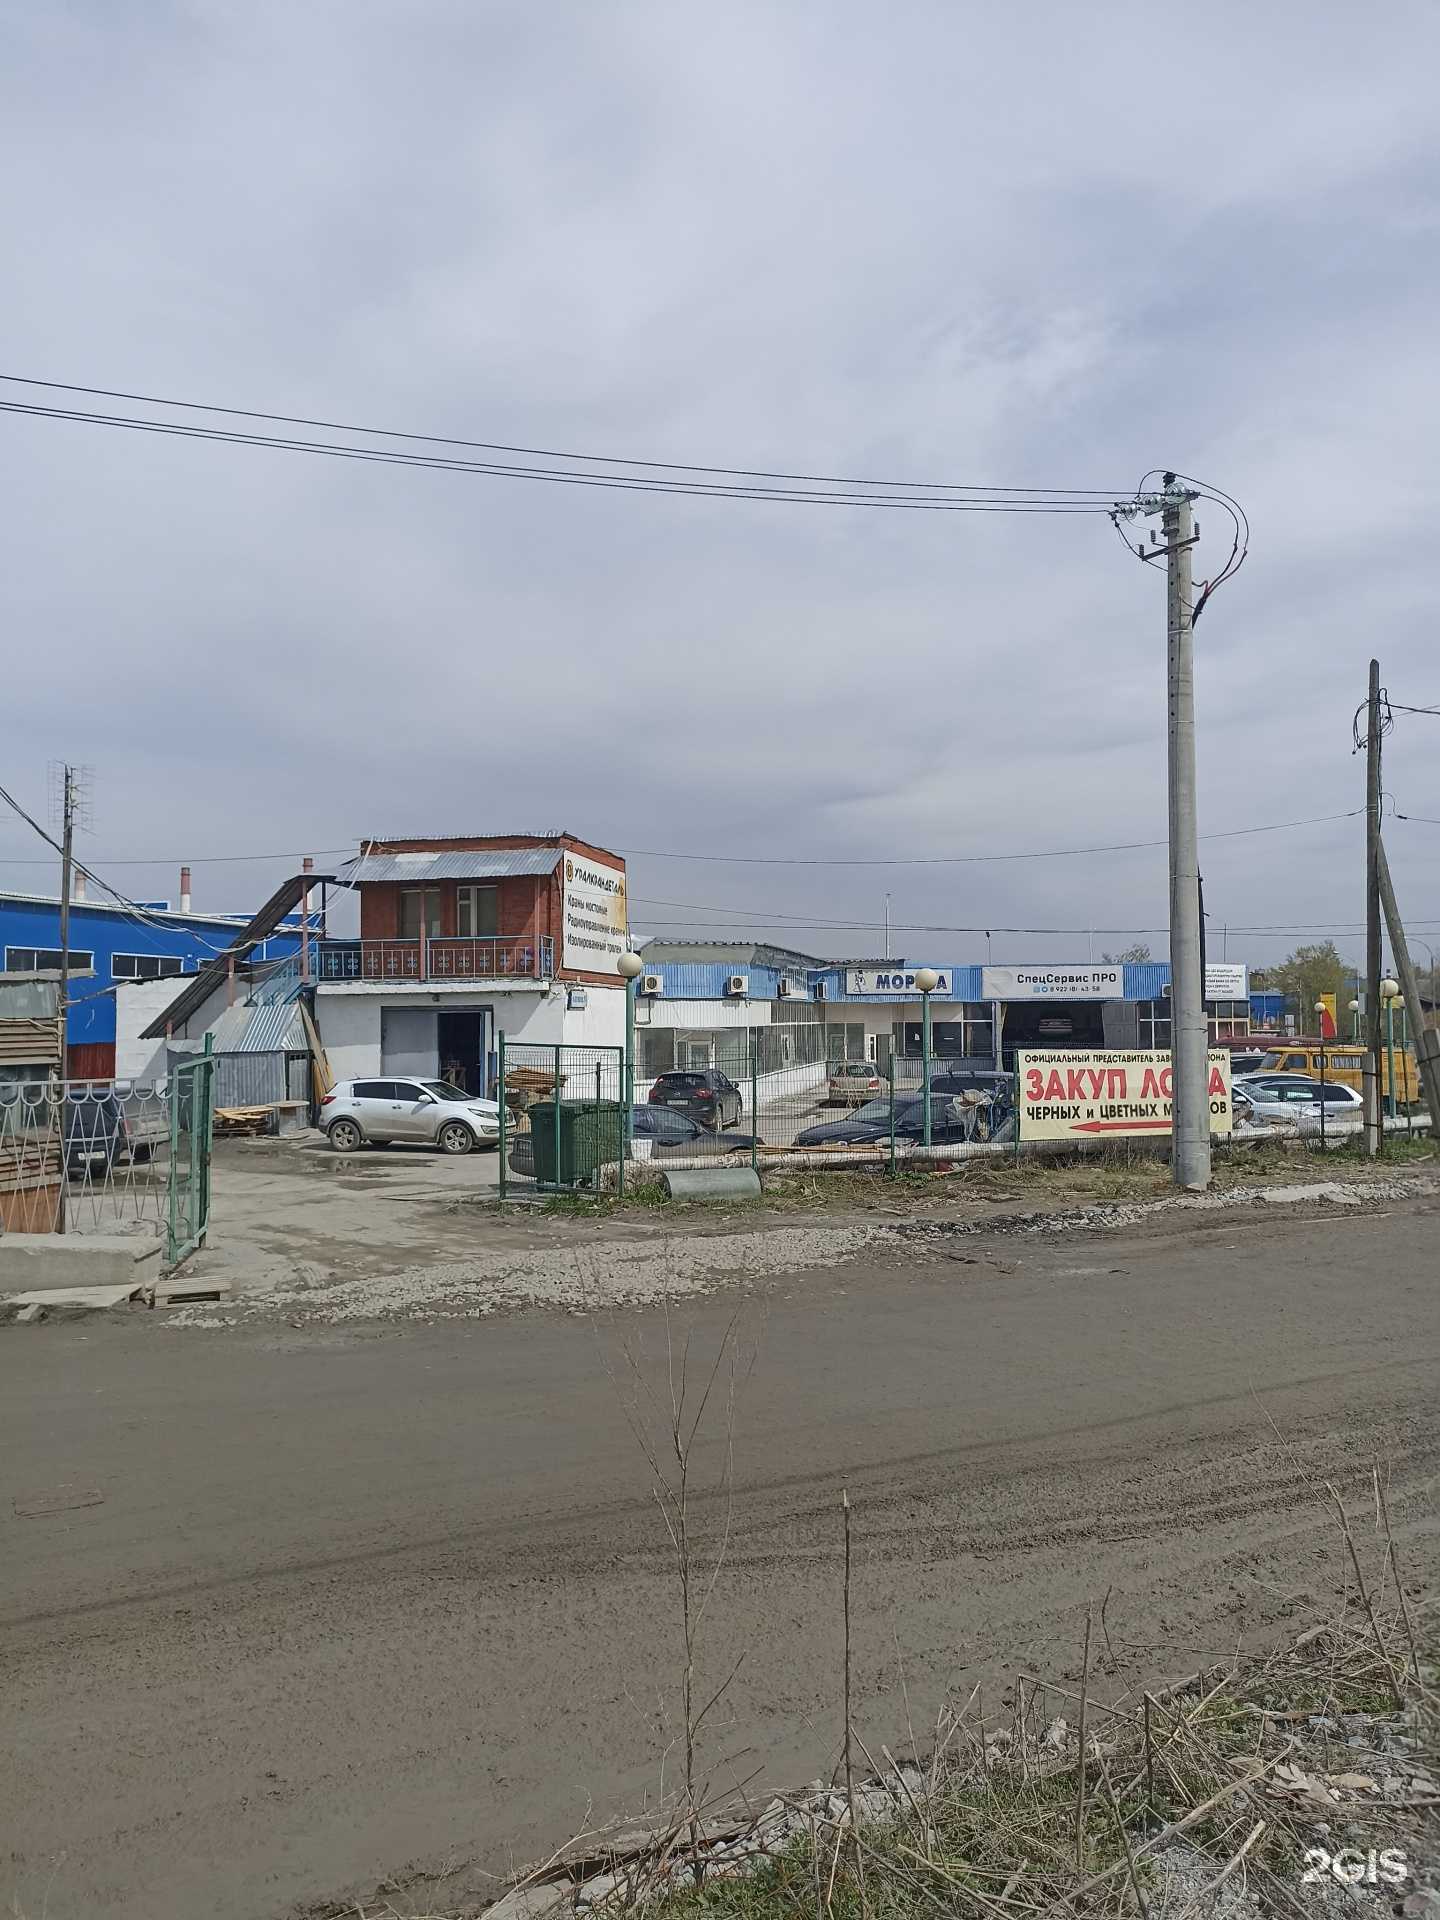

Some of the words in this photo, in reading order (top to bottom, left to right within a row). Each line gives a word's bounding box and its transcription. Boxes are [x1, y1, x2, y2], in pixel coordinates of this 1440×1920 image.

[876, 974, 947, 989] МОРА
[1017, 973, 1089, 984] СпецСервис
[1092, 973, 1117, 983] ПРО
[1024, 1053, 1090, 1064] ОФИЦИАЛЬНЫЙ
[1093, 1054, 1154, 1064] ПРЕДСТАВИТЕЛЬ
[1156, 1054, 1172, 1063] ЗАВ
[1026, 1069, 1127, 1101] ЗАКУП
[1140, 1067, 1227, 1099] ЛОА
[1027, 1105, 1080, 1121] ЧЕРНЫХ
[1086, 1108, 1094, 1119] и
[1100, 1103, 1159, 1120] ЦВЕТНЫХ
